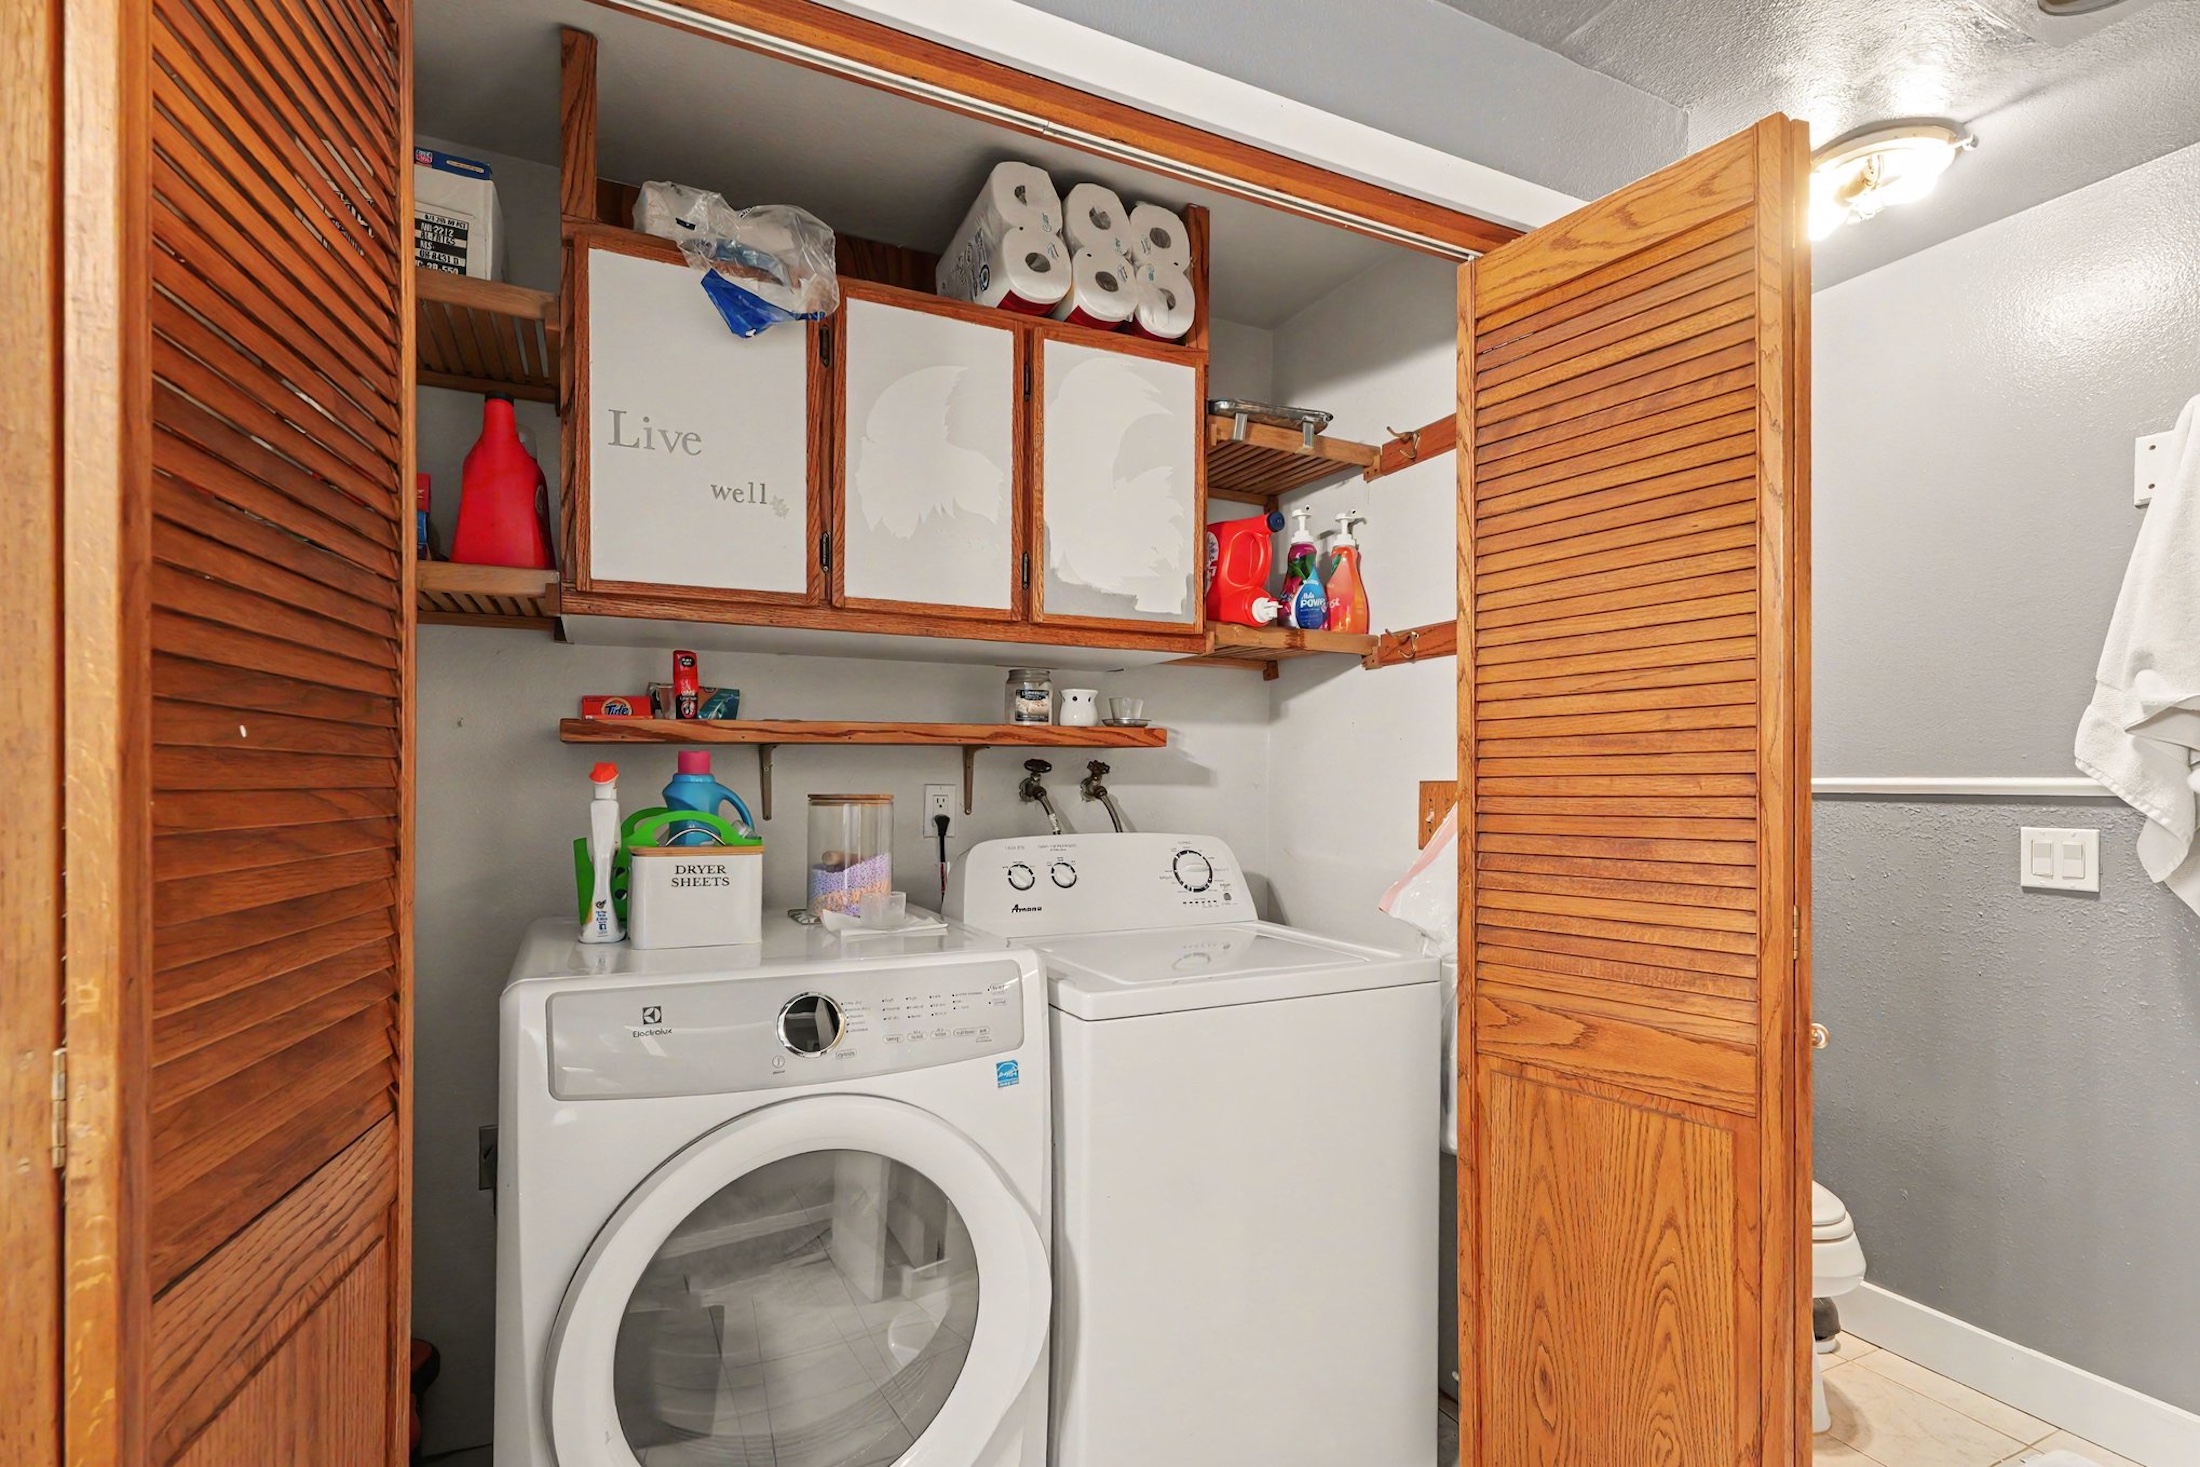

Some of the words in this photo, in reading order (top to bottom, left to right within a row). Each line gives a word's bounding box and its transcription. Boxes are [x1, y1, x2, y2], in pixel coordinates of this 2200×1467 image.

[607, 408, 702, 456] Live
[710, 481, 768, 505] well
[604, 701, 630, 716] Tide
[674, 864, 727, 875] DRYER
[671, 876, 731, 888] SHEETS
[632, 1028, 673, 1038] Electrolux
